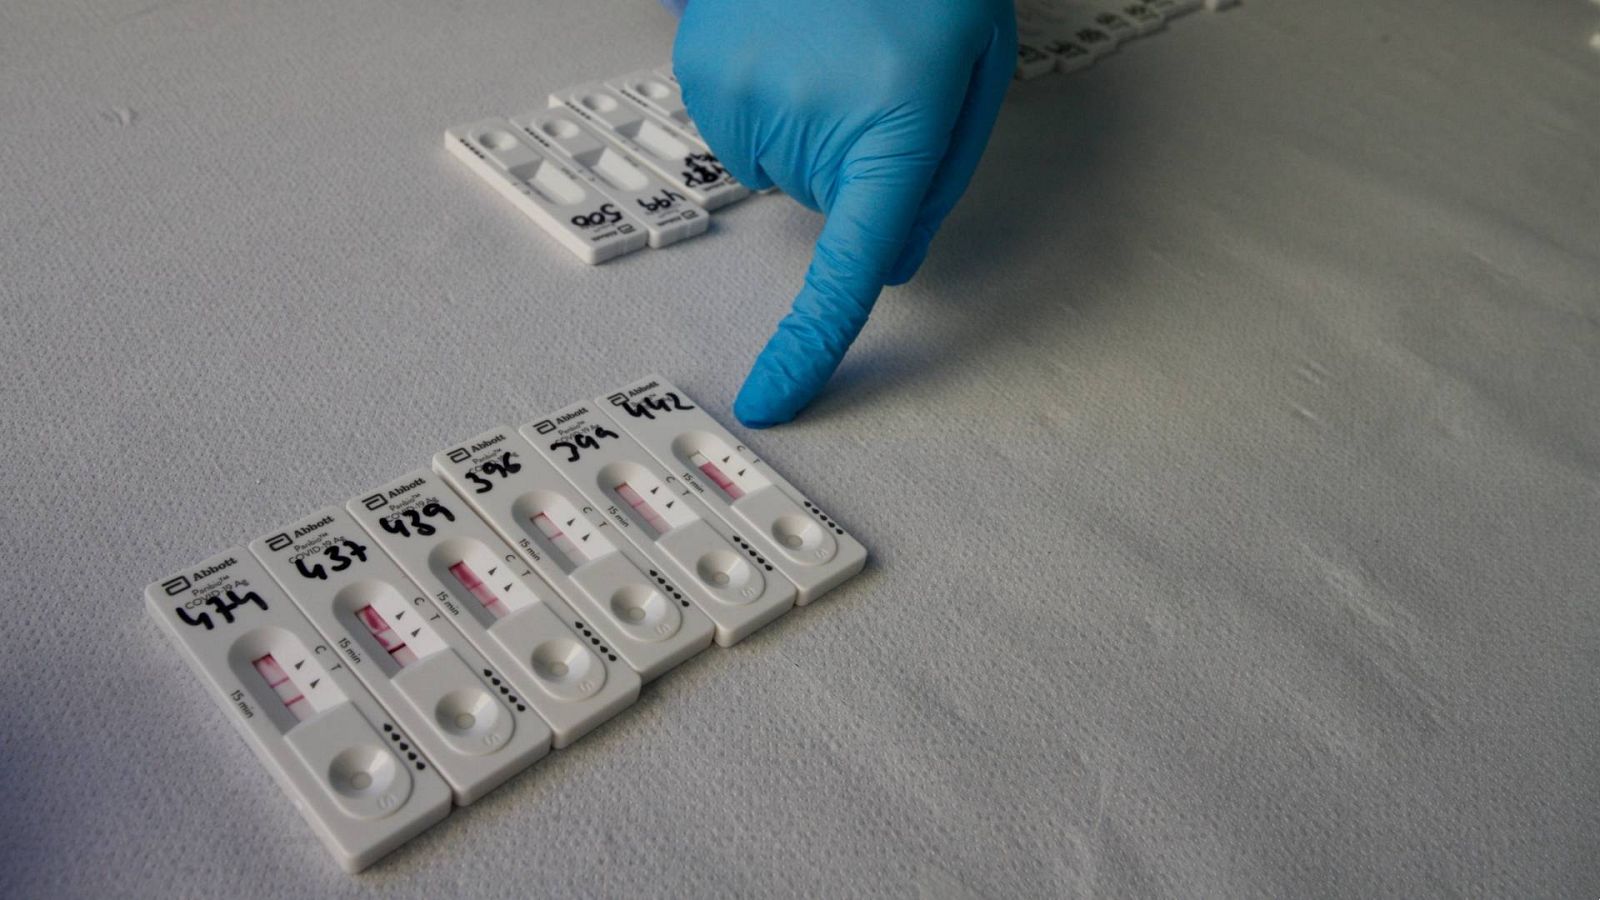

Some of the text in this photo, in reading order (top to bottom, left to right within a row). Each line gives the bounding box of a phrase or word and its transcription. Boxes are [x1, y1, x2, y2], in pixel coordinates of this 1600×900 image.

[571, 203, 623, 226] 500
[629, 381, 659, 397] Abbott
[556, 407, 589, 424] Abbott
[471, 434, 506, 453] Abbott
[465, 451, 522, 494] 396
[665, 475, 677, 484] C
[388, 477, 426, 498] Abbott
[582, 506, 593, 514] C
[606, 505, 630, 529] 15 min
[294, 515, 335, 538] Abbott
[295, 540, 367, 580] 437
[504, 553, 516, 563] C
[518, 538, 541, 562] 15 min
[193, 557, 237, 581] Abbott
[521, 569, 532, 577] T
[413, 596, 425, 606] C
[436, 590, 460, 616] 15 min
[430, 613, 441, 621] T
[314, 645, 327, 656] C
[337, 637, 361, 664] 15 min
[330, 663, 342, 672] T
[231, 689, 255, 719] 15 min
